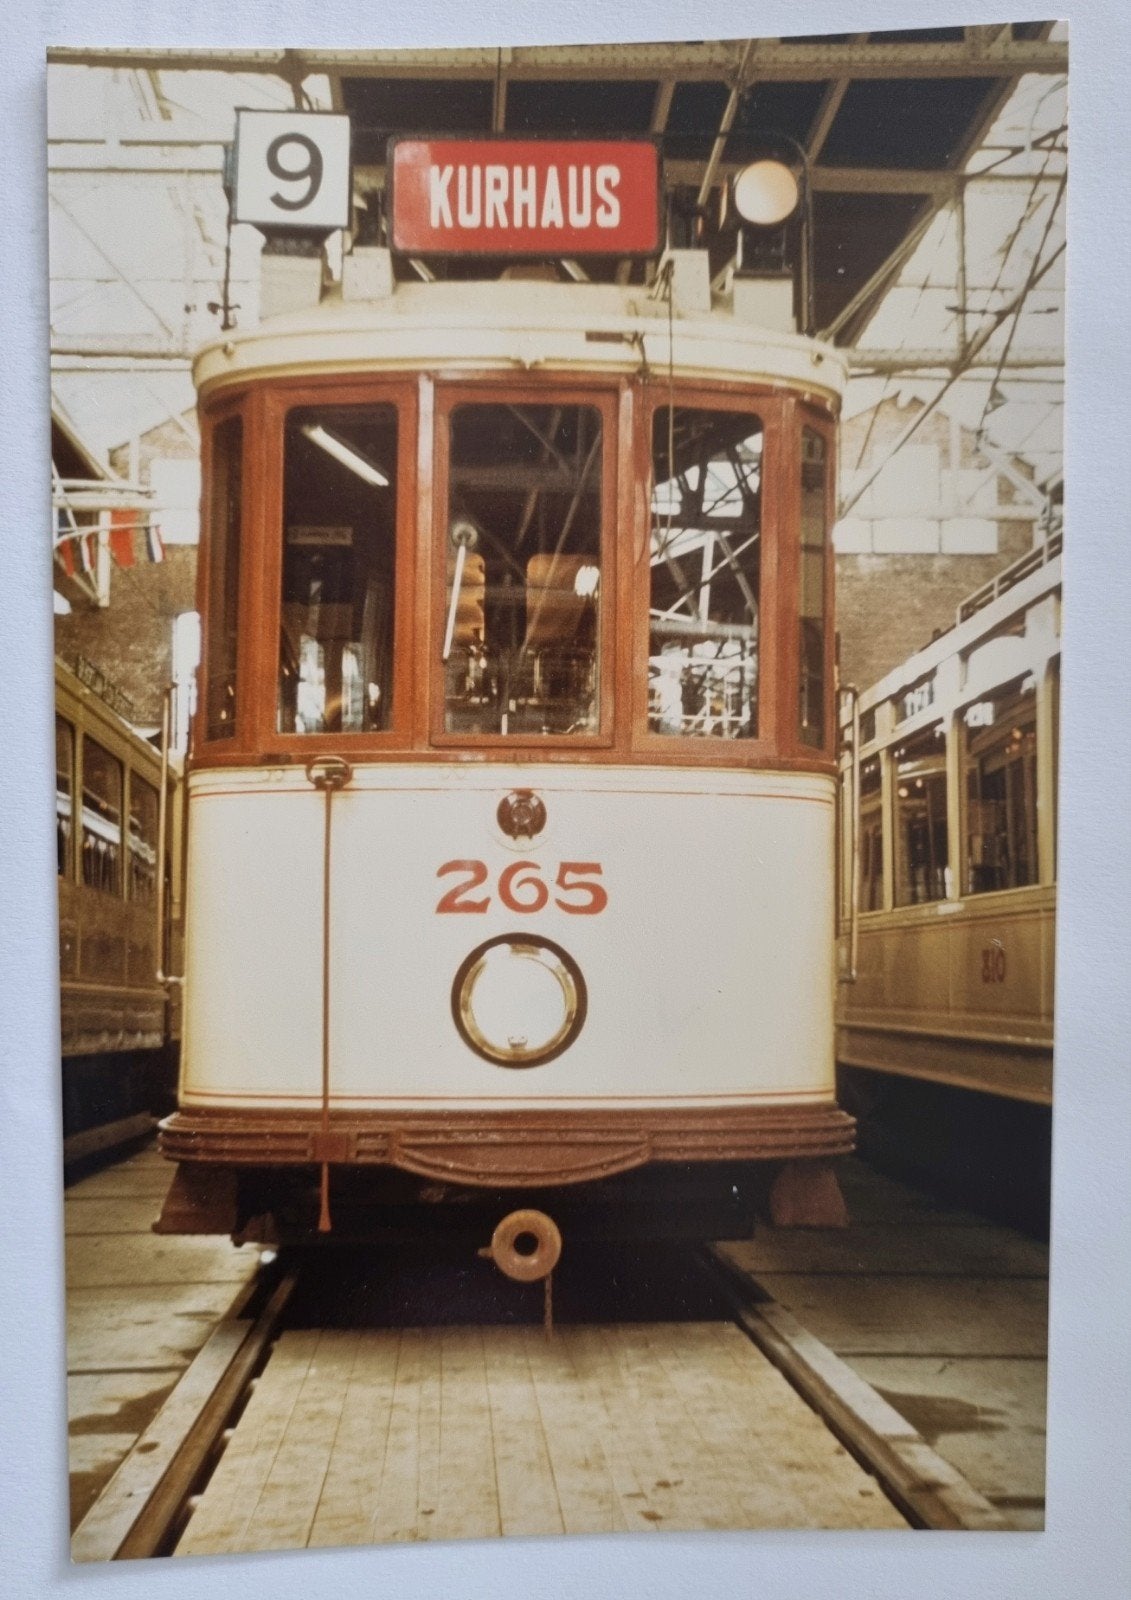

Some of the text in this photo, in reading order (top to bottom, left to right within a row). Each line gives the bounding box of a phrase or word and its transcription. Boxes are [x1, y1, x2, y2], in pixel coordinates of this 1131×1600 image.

[267, 132, 323, 211] 9
[430, 165, 621, 229] KURHAUS
[435, 859, 608, 914] 265
